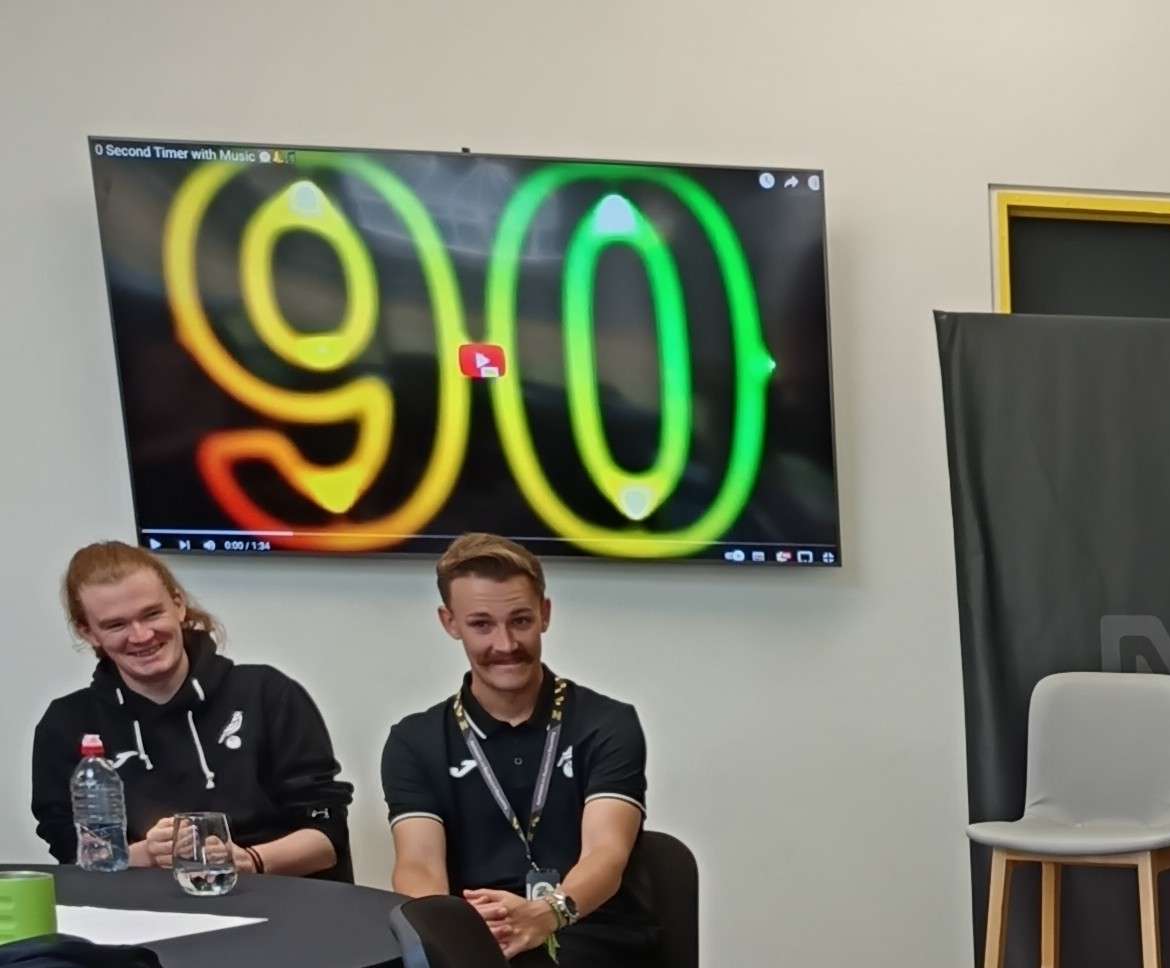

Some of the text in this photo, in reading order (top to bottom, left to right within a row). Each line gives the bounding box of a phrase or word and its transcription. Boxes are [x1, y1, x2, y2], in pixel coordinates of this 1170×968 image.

[105, 144, 152, 158] Second
[153, 146, 188, 159] Timer
[191, 148, 217, 161] with
[218, 149, 256, 162] Music
[162, 150, 774, 558] 90
[224, 541, 244, 550] 0:00
[251, 541, 271, 550] 1:34
